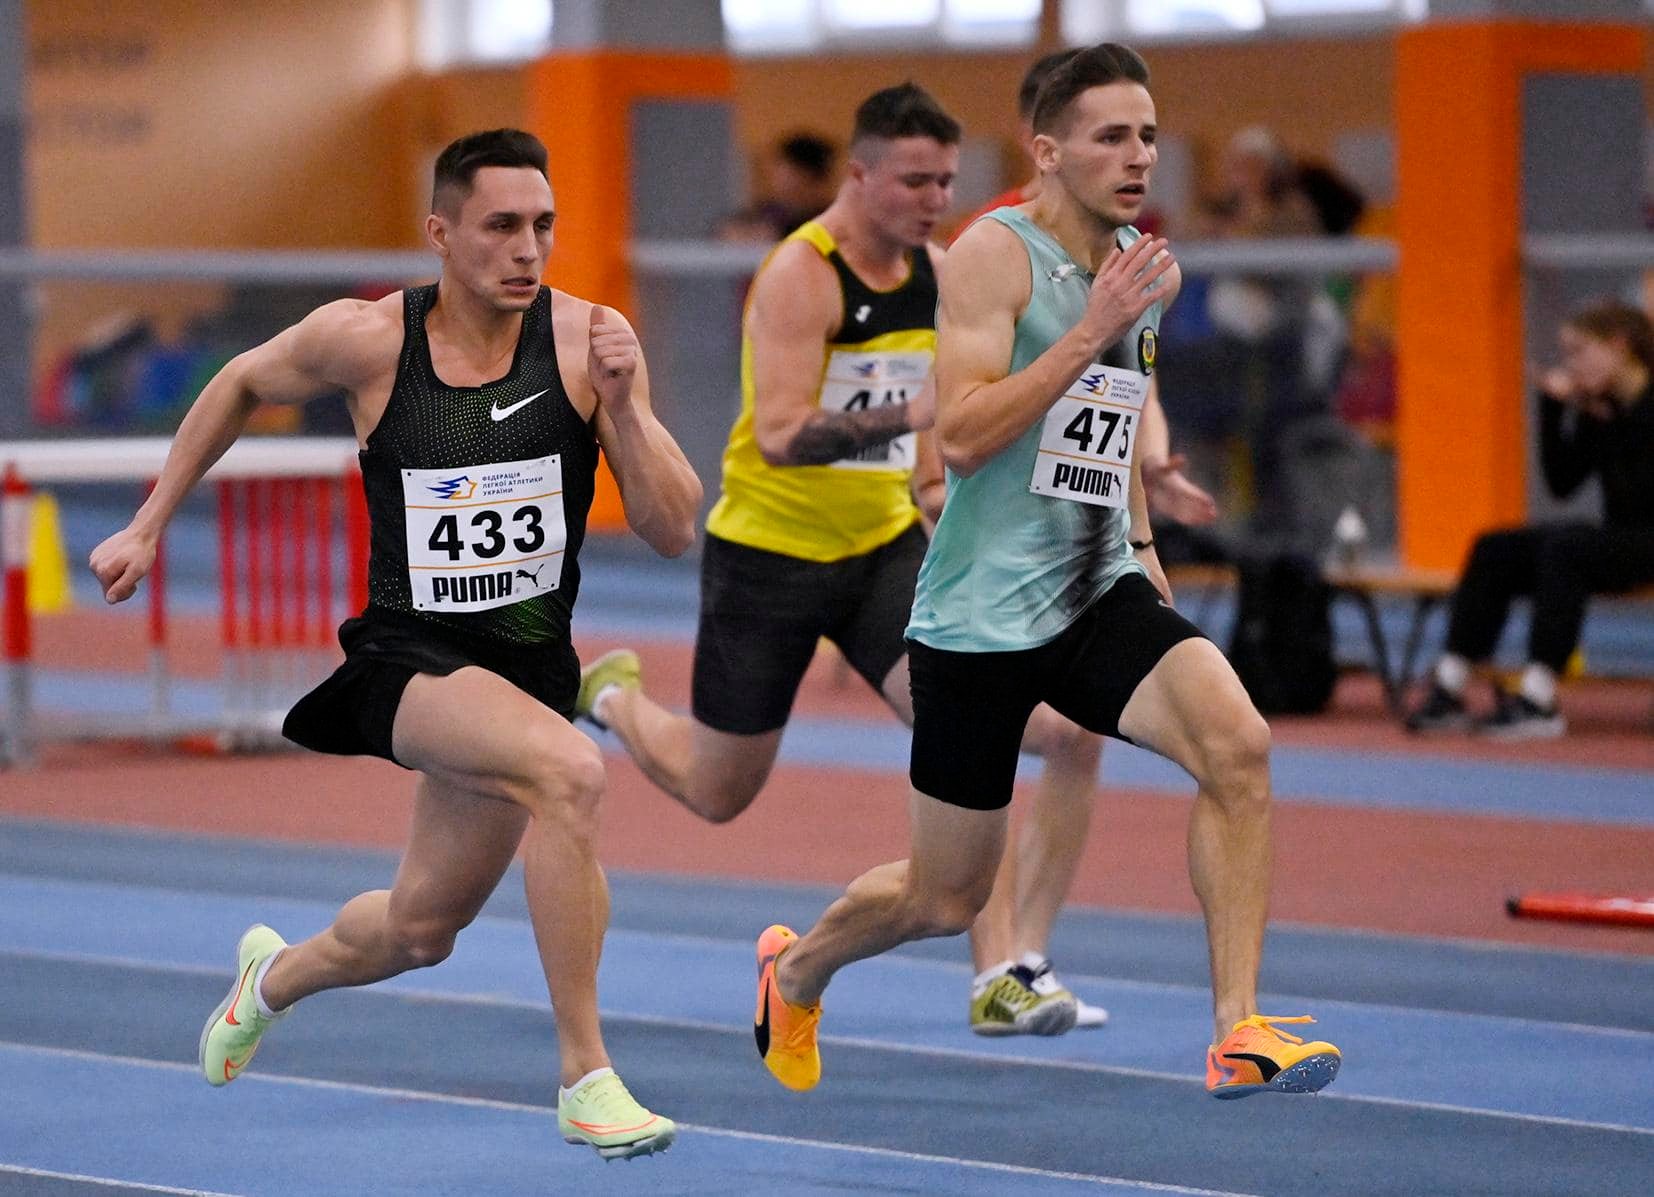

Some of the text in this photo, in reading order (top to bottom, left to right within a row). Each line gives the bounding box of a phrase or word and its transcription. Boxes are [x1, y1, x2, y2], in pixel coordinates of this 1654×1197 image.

[1063, 407, 1131, 459] 475
[482, 472, 520, 481] ФЕДЕРАЦІЯ
[482, 476, 543, 488] ЛЕГКОЇ АТЛЕТИКИ
[482, 488, 513, 496] УКРАЇНИ
[1052, 463, 1112, 497] PUMA
[428, 505, 545, 560] 433
[432, 571, 513, 602] PUMA
